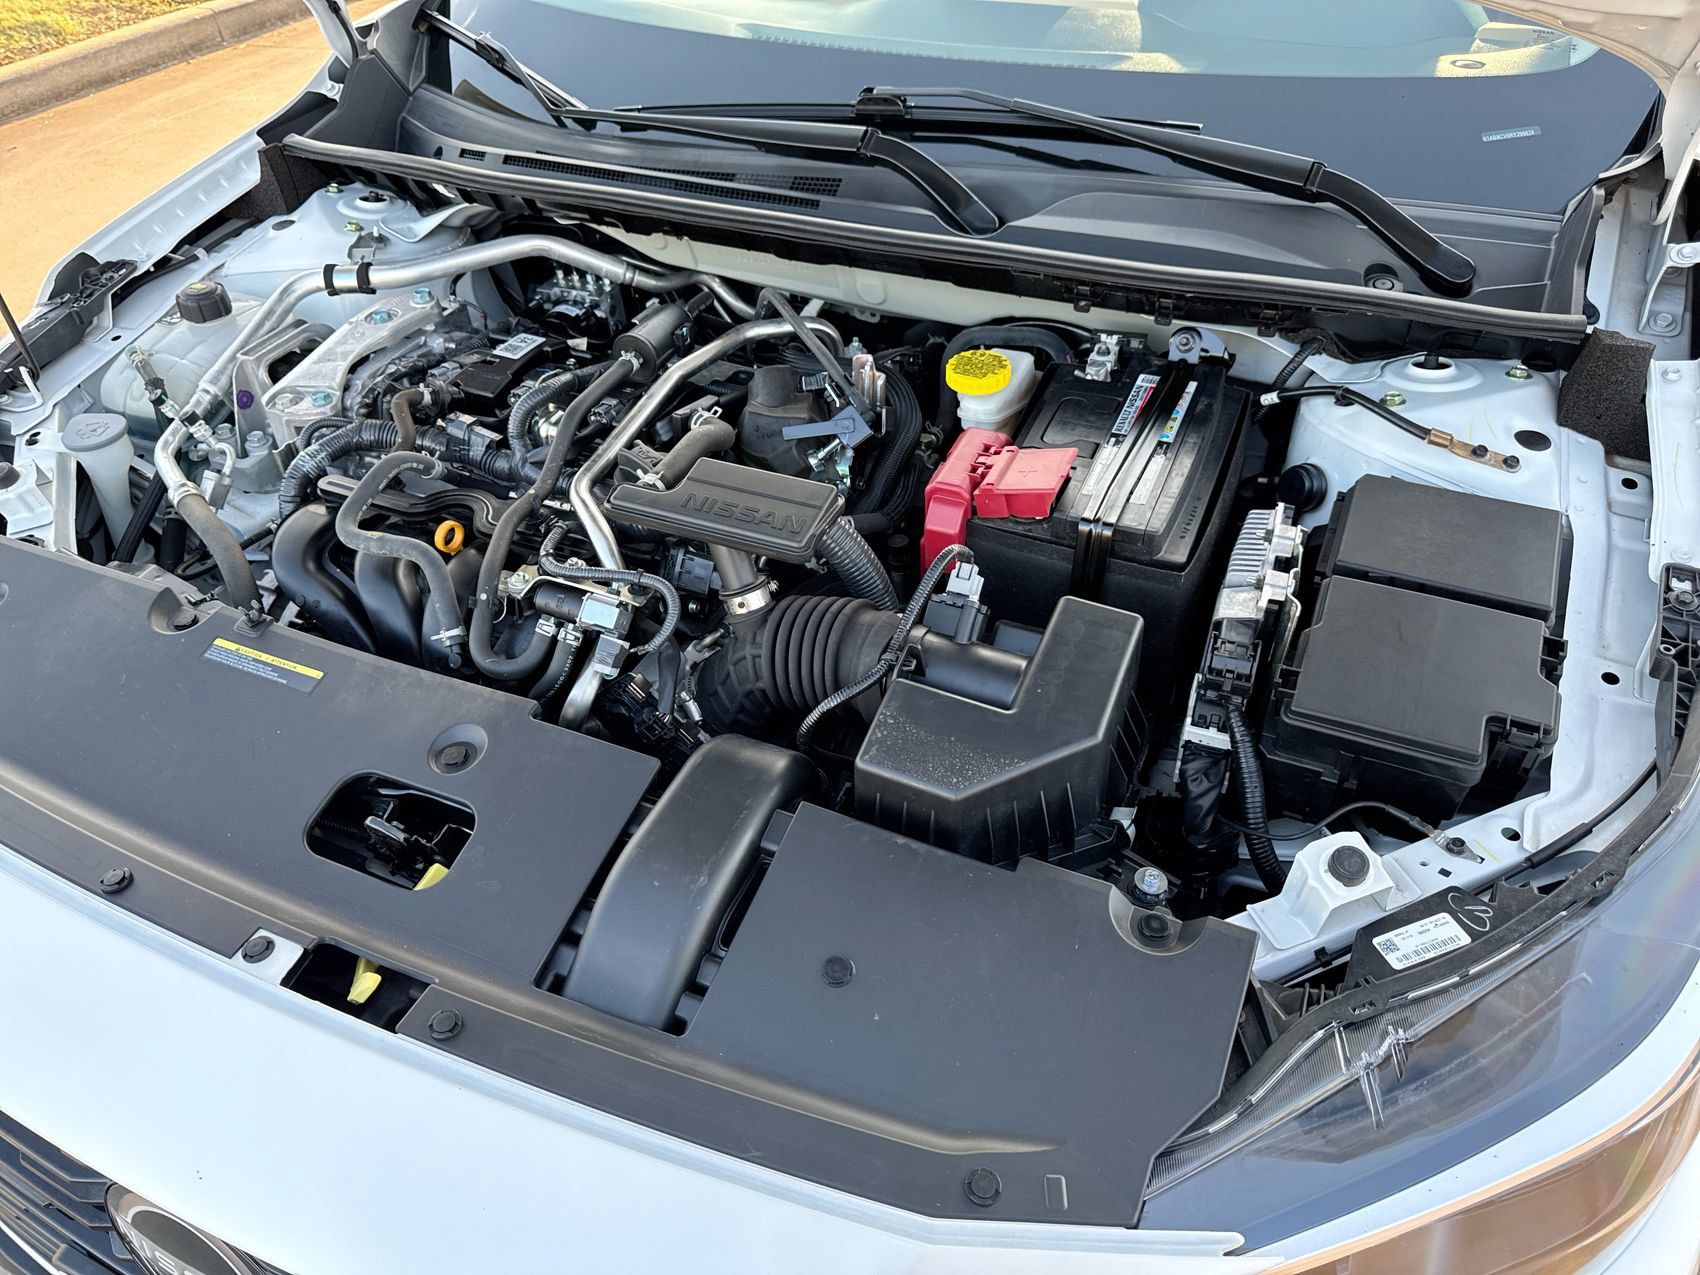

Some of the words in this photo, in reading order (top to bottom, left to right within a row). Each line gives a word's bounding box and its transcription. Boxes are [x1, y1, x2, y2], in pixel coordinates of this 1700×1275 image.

[1114, 409, 1131, 432] RENAULT
[1126, 384, 1144, 409] NISSAN
[680, 492, 807, 535] NISSAN
[240, 647, 262, 659] CAUTION
[271, 658, 298, 670] ATTENTION
